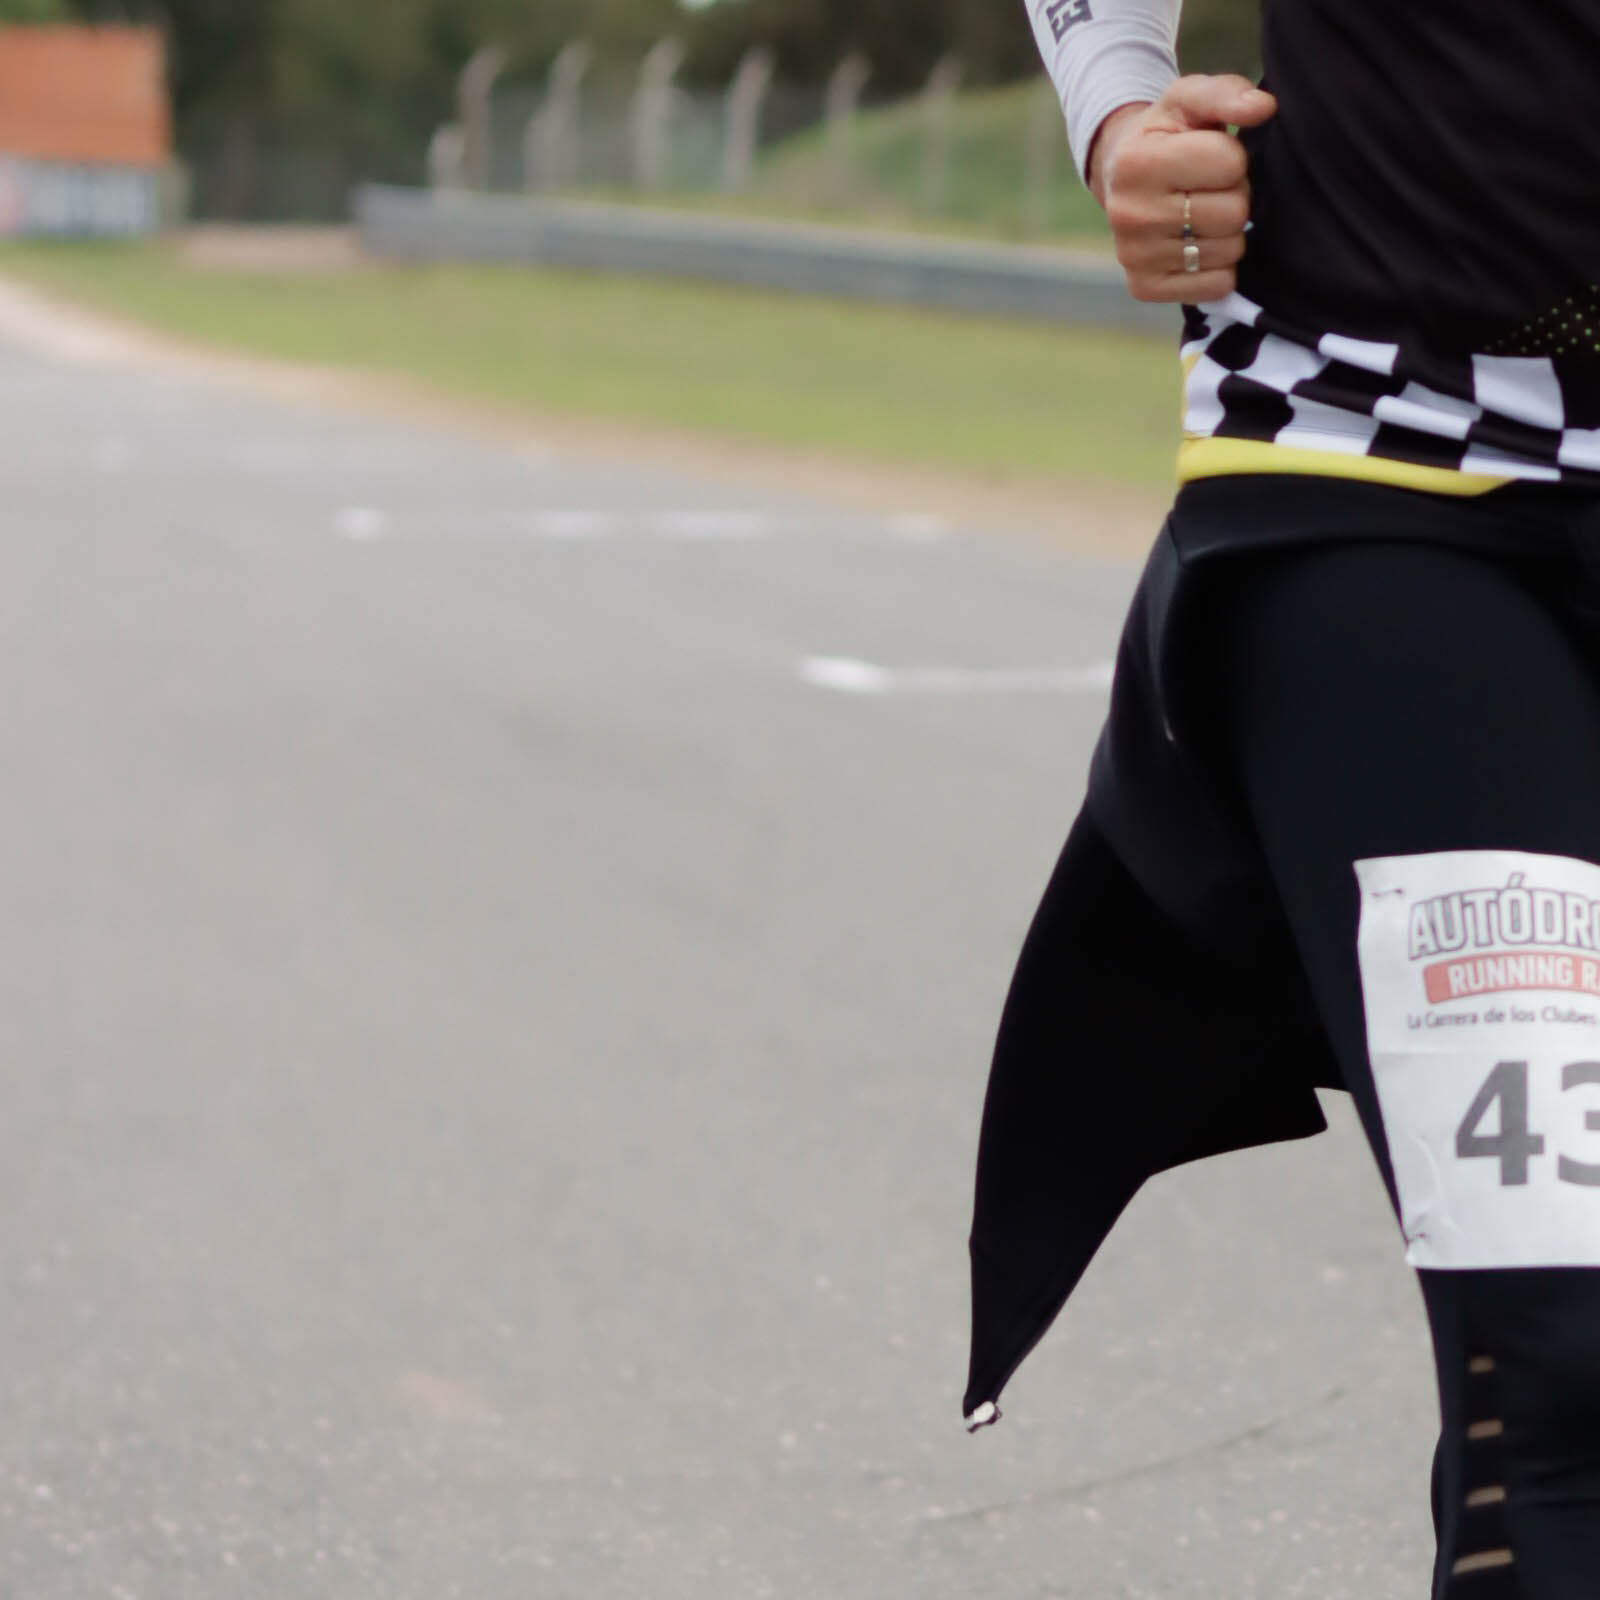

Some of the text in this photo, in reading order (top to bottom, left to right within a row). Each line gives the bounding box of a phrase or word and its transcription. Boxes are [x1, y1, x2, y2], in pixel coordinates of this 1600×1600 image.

[1449, 954, 1574, 997] RUNNING
[1425, 1010, 1478, 1029] Carrera
[1484, 1005, 1505, 1024] de
[1511, 1003, 1536, 1023] los
[1541, 1004, 1597, 1025] Clubes
